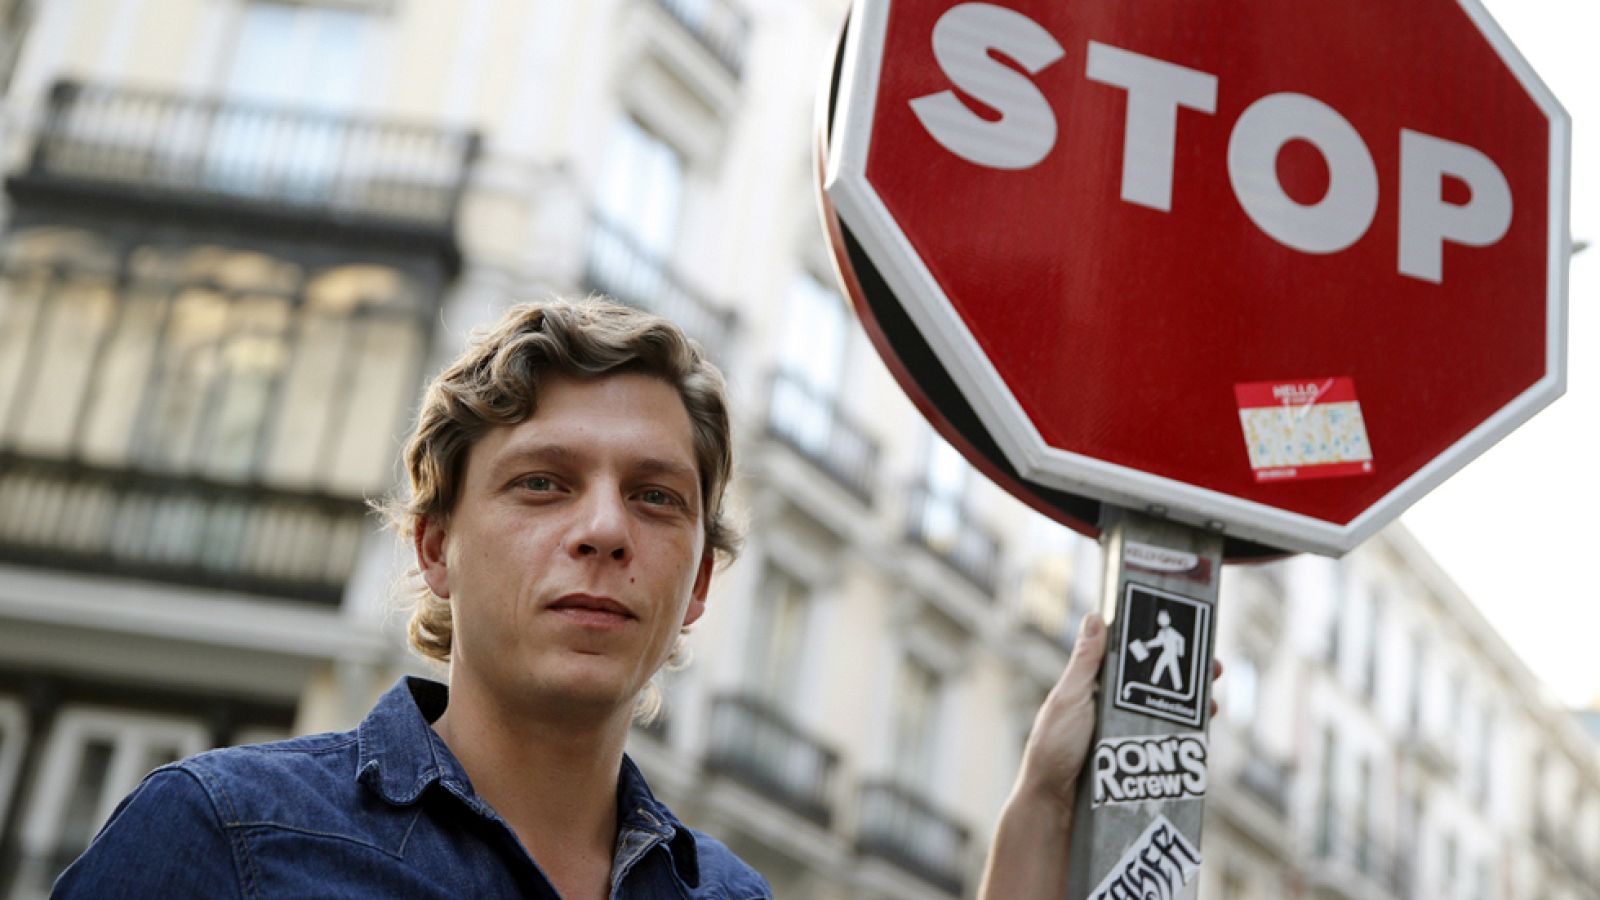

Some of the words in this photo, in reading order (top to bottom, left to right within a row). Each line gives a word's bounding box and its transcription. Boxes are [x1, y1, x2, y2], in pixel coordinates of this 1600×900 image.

[908, 2, 1513, 284] STOP
[1272, 383, 1319, 399] HELLO
[1093, 738, 1207, 801] RON'S
[1121, 773, 1183, 798] crew
